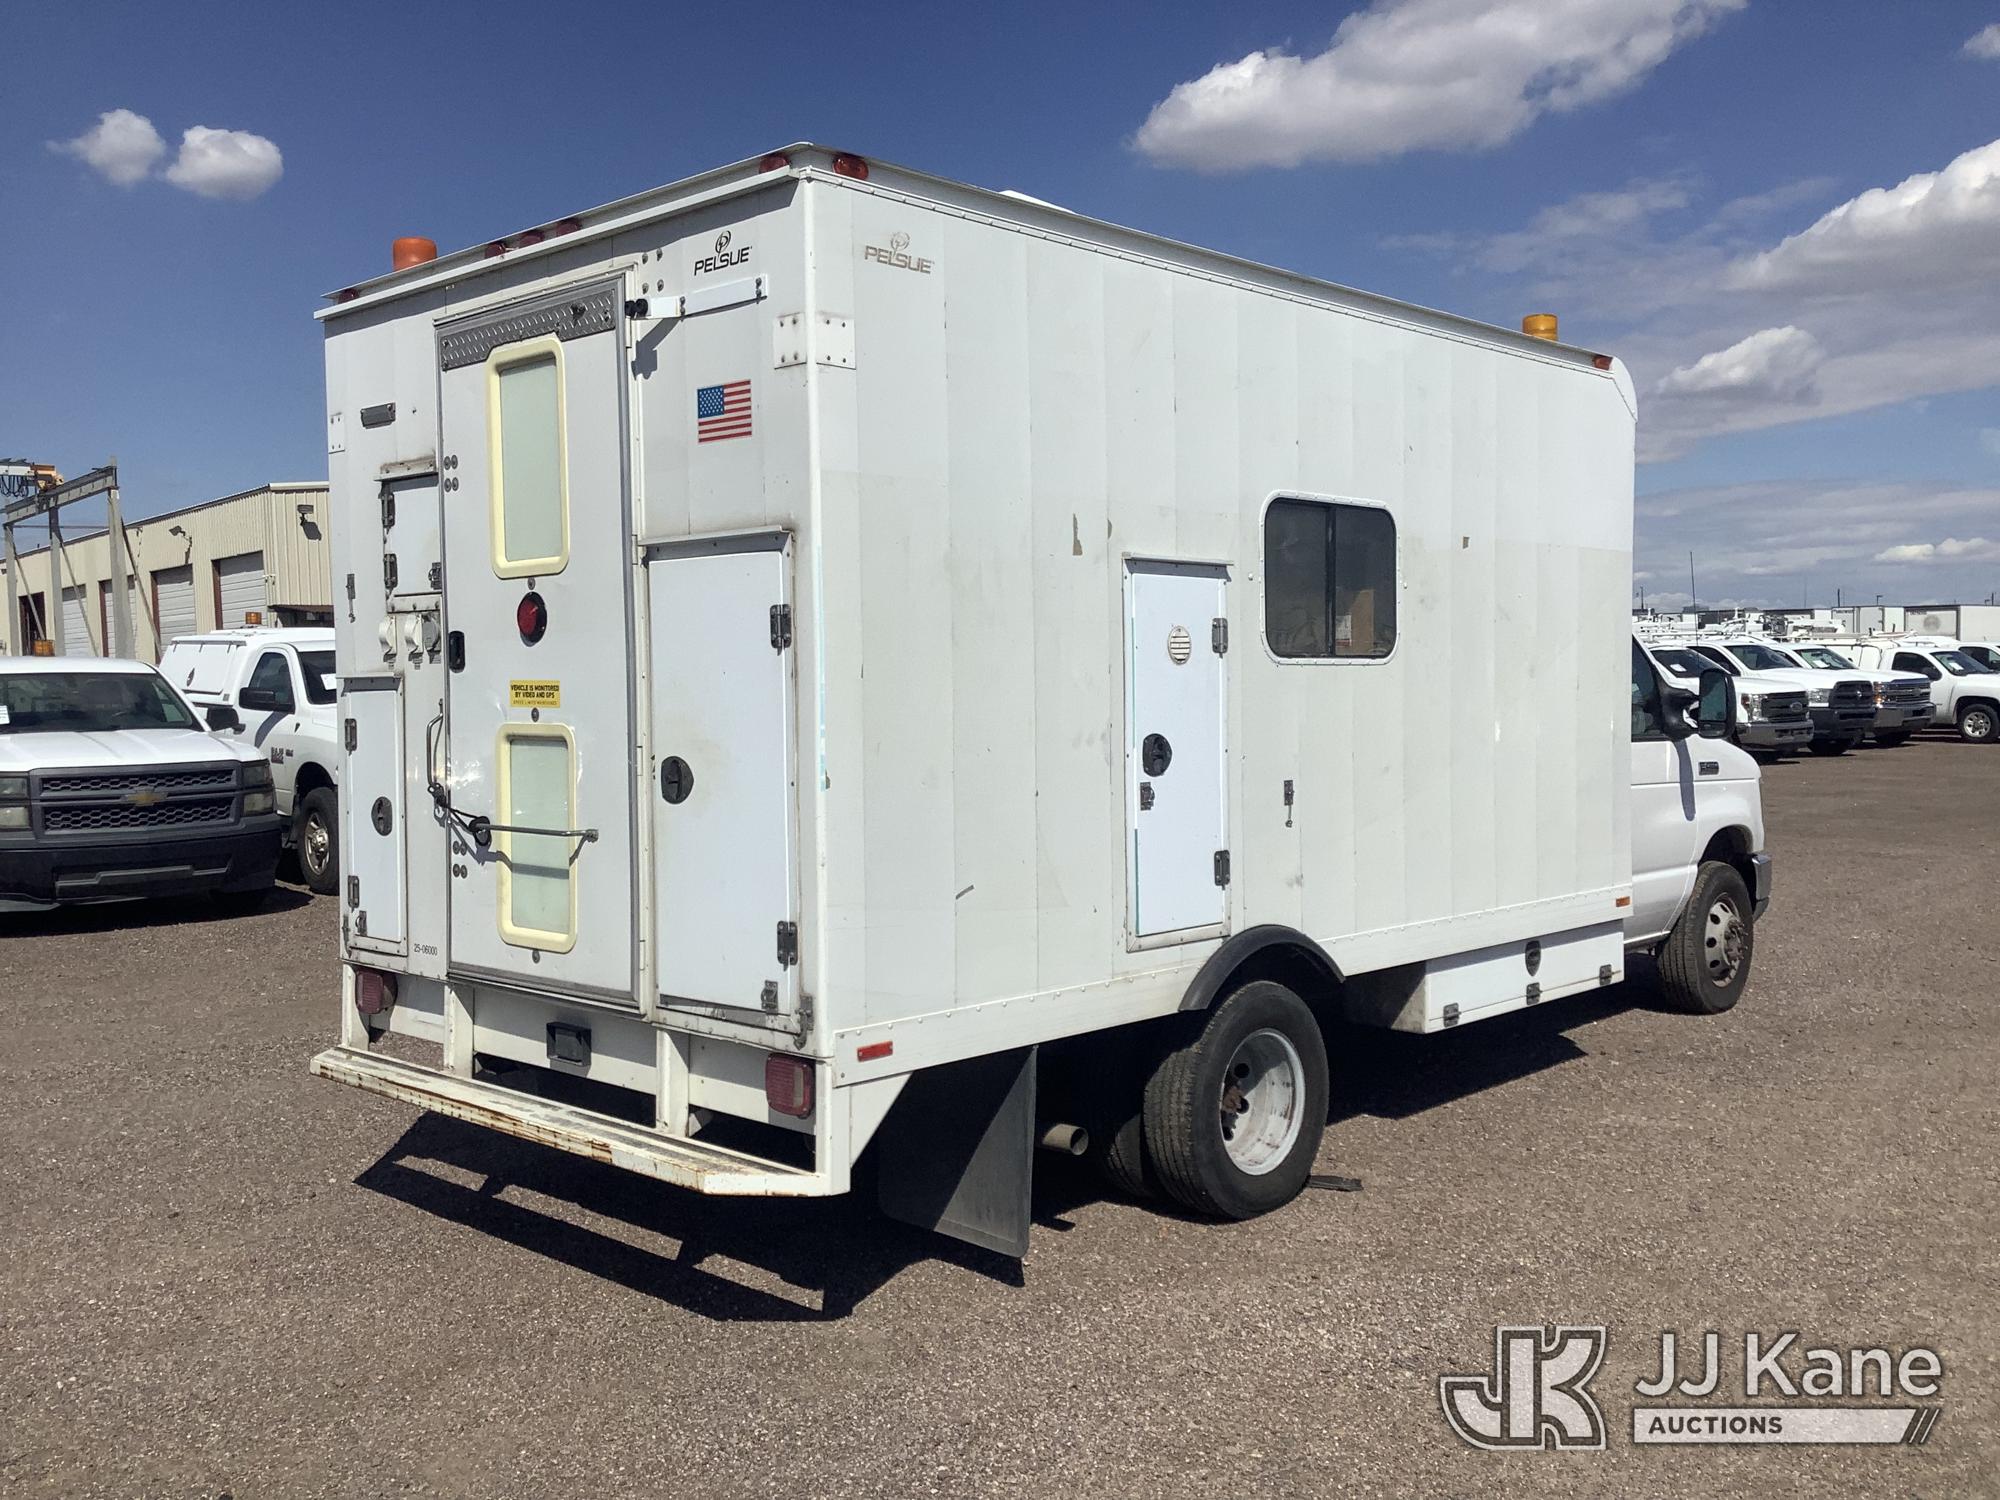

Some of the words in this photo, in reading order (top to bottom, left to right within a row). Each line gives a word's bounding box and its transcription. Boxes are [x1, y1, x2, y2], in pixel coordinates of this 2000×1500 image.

[694, 246, 750, 276] PELSUE
[864, 245, 932, 275] PELSUE
[546, 691, 555, 699] GPS
